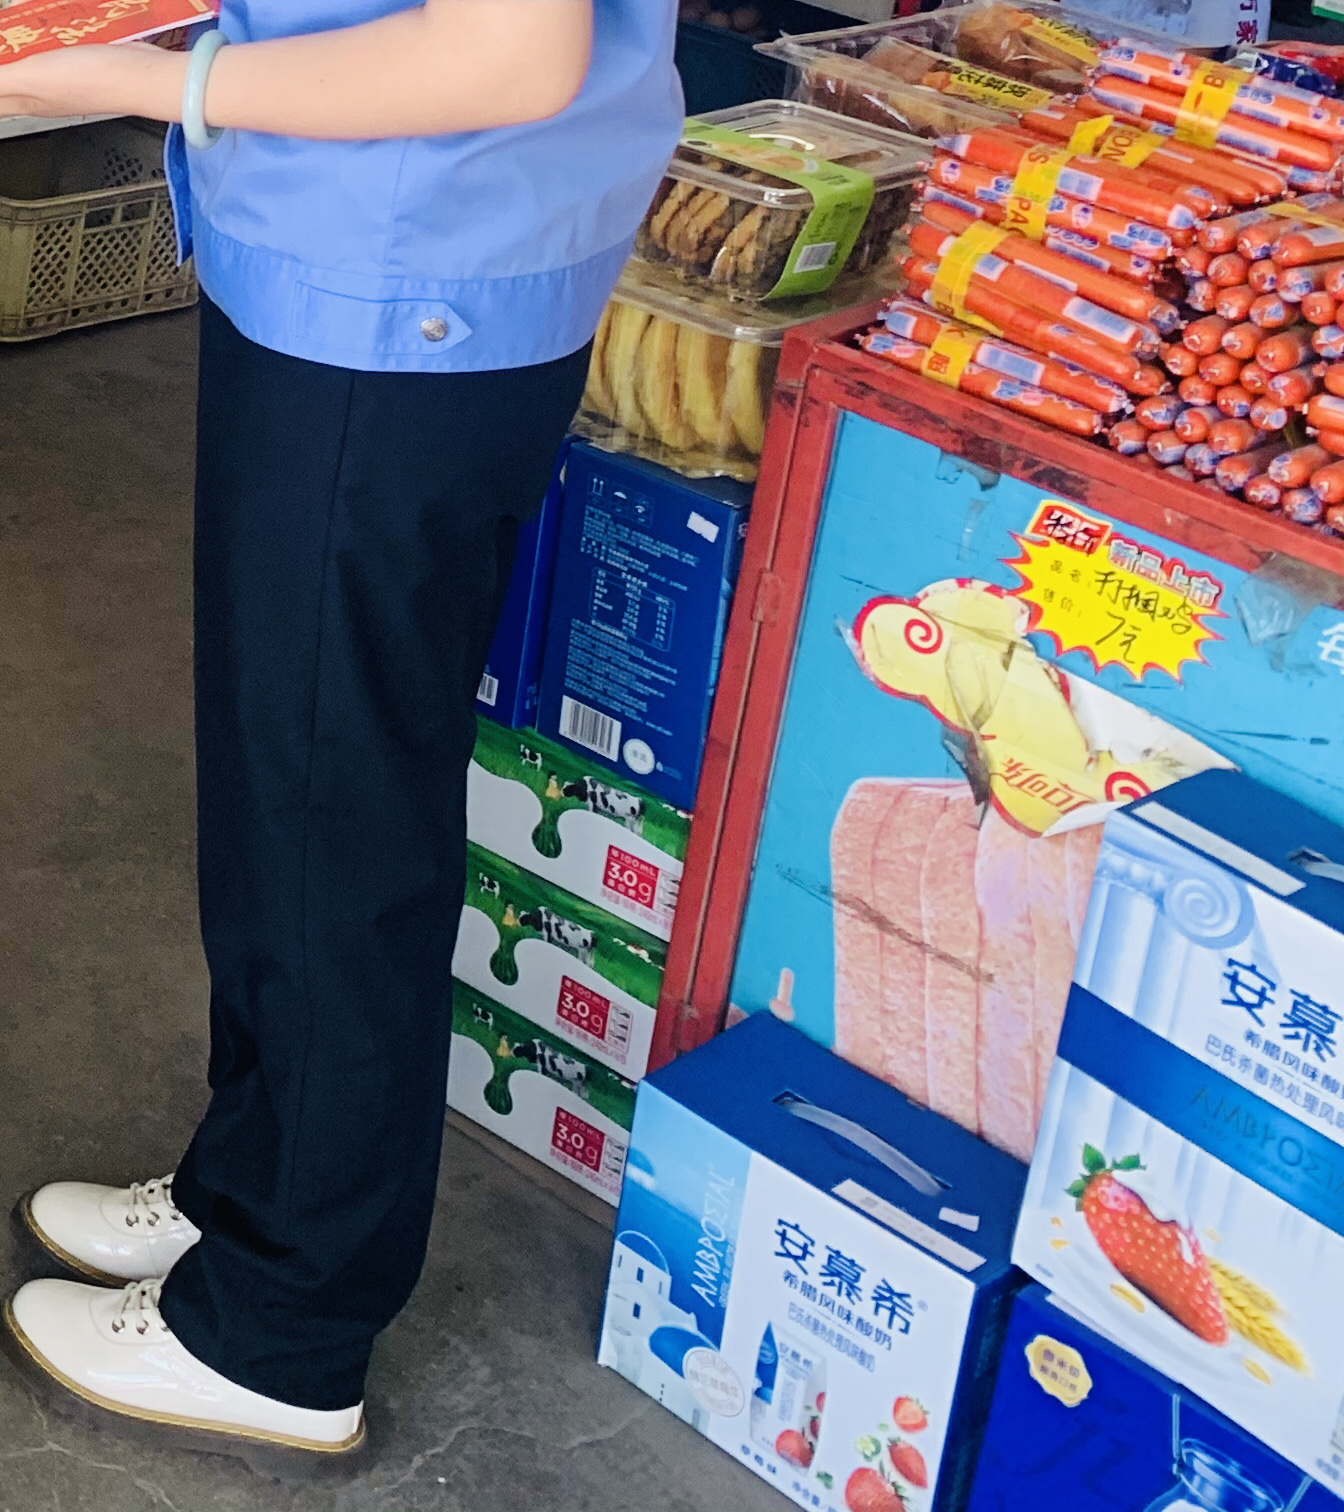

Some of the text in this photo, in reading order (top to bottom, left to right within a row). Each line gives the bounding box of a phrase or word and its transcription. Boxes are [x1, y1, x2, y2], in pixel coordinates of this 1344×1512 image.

[1109, 538, 1221, 608] 新品上市
[1095, 611, 1143, 665] 7元
[1221, 958, 1344, 1062] 安慕
[774, 1218, 915, 1336] 安慕希
[783, 1269, 893, 1352] 希腊风味酸奶
